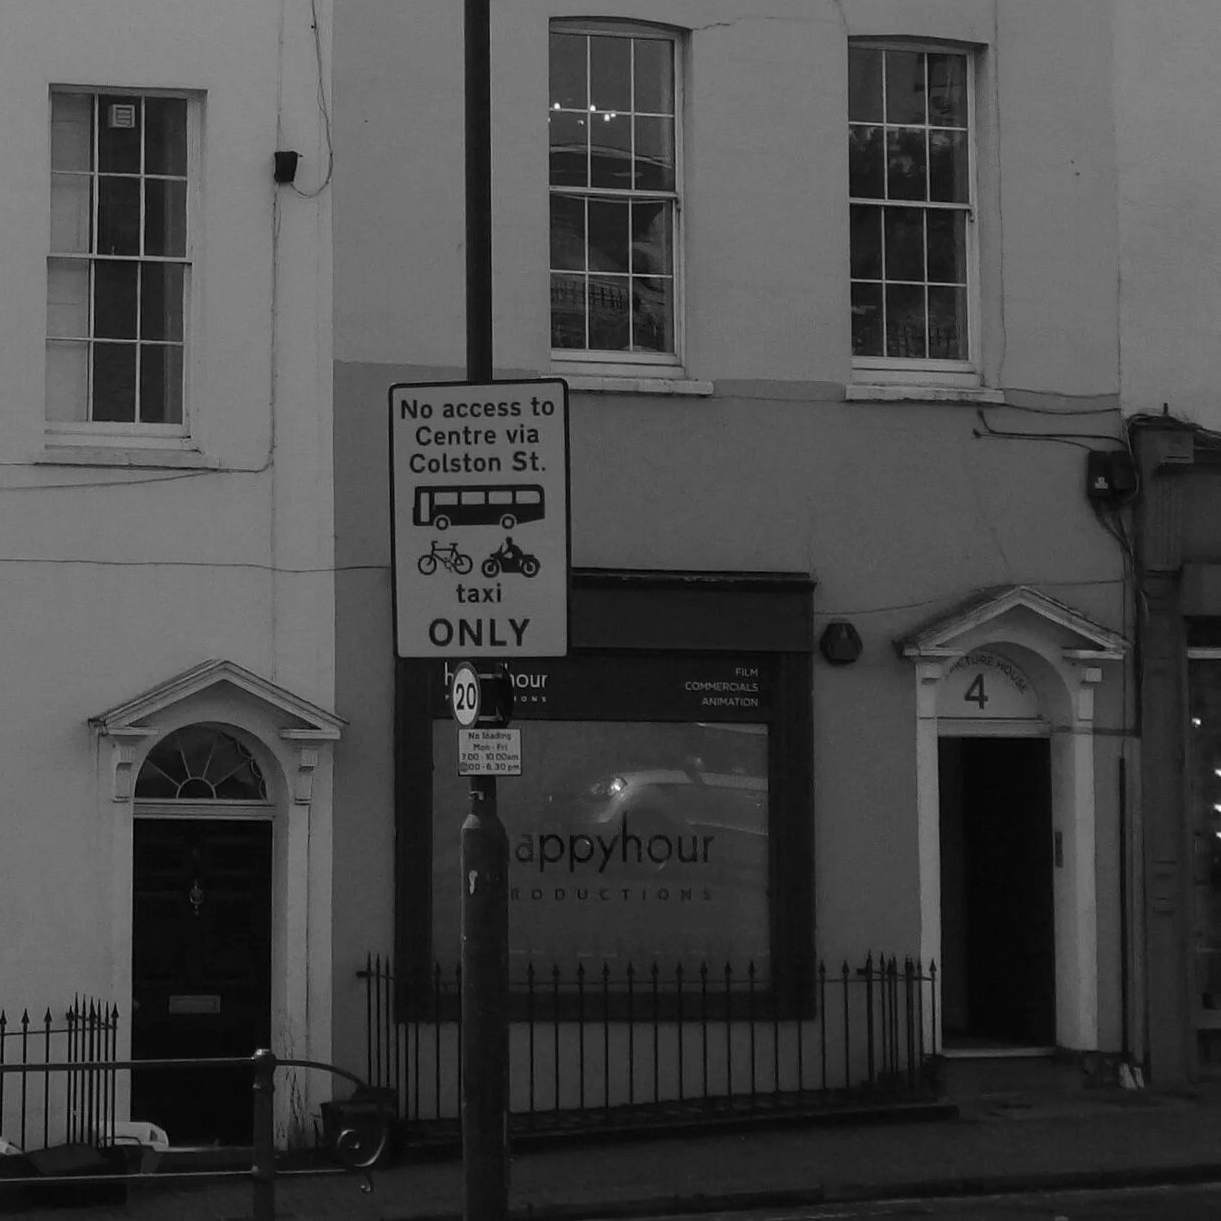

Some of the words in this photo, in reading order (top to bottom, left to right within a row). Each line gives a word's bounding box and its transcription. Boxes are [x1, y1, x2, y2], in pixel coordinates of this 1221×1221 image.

[400, 399, 433, 420] No
[442, 401, 521, 419] access
[530, 396, 555, 417] to
[415, 425, 497, 447] Centre
[505, 423, 540, 445] via
[409, 452, 501, 474] Colston
[512, 450, 547, 473] St.
[456, 582, 502, 604] taxi
[428, 617, 531, 648] ONLY
[735, 666, 759, 678] FILM
[455, 682, 477, 711] 20
[685, 682, 759, 692] COMMERCIALS
[964, 673, 989, 710] 4
[701, 697, 759, 707] ANIMATION
[473, 743, 491, 751] Mon
[497, 743, 508, 751] Fri
[514, 809, 716, 874] appyhour
[510, 887, 713, 902] RODUCTIONS
